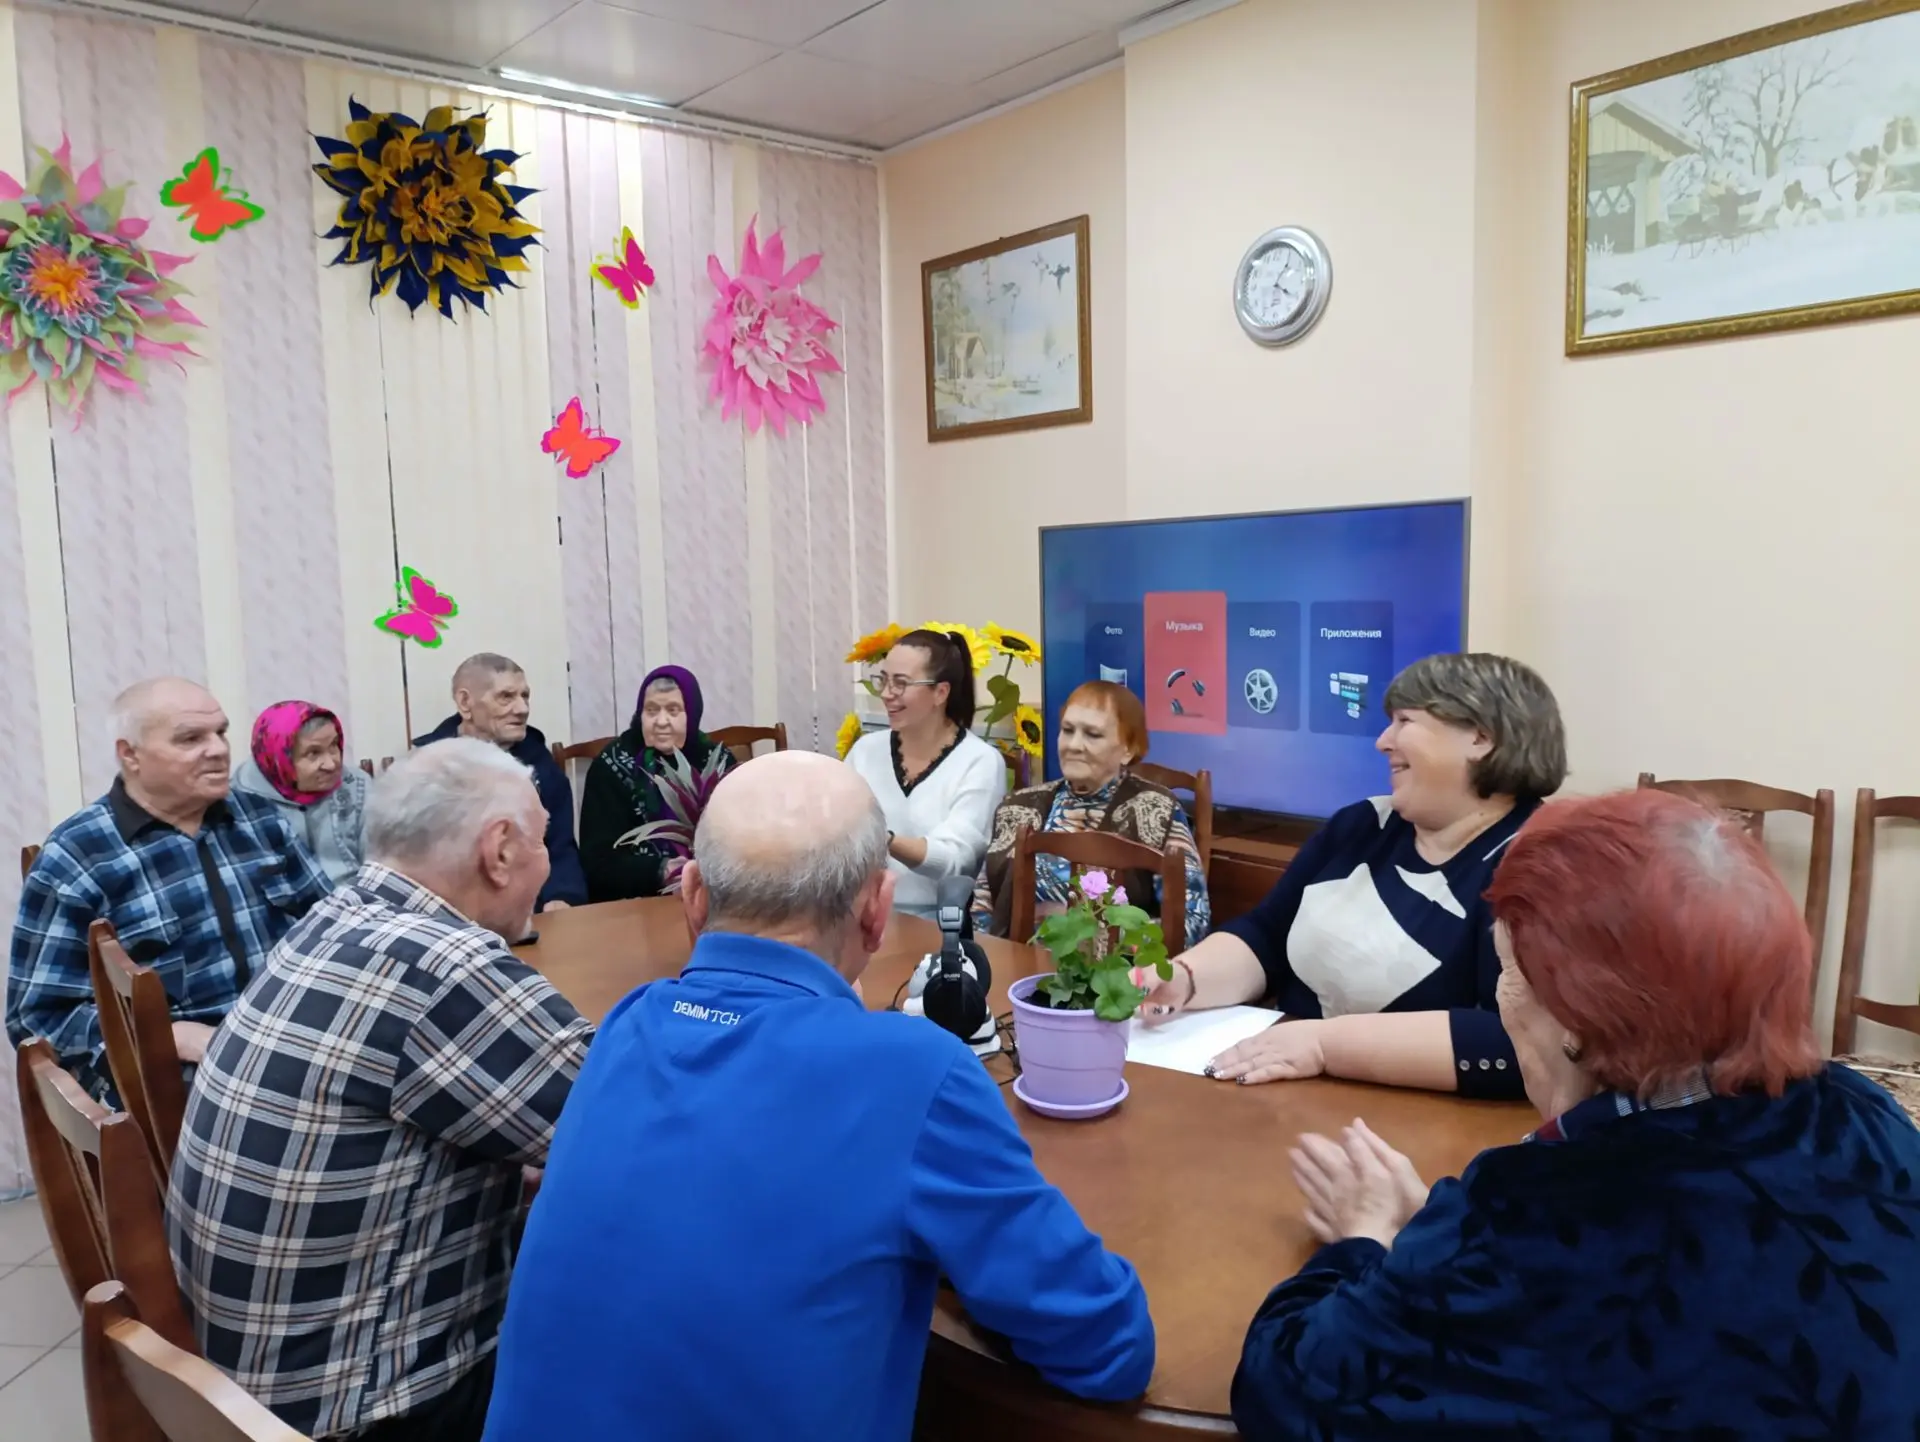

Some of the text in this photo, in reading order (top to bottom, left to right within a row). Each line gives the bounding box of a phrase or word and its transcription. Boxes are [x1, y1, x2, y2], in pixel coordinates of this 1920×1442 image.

[1104, 625, 1124, 636] Фото
[1165, 619, 1204, 634] Музыка
[1249, 627, 1277, 638] Видео
[1319, 627, 1383, 640] Приложения
